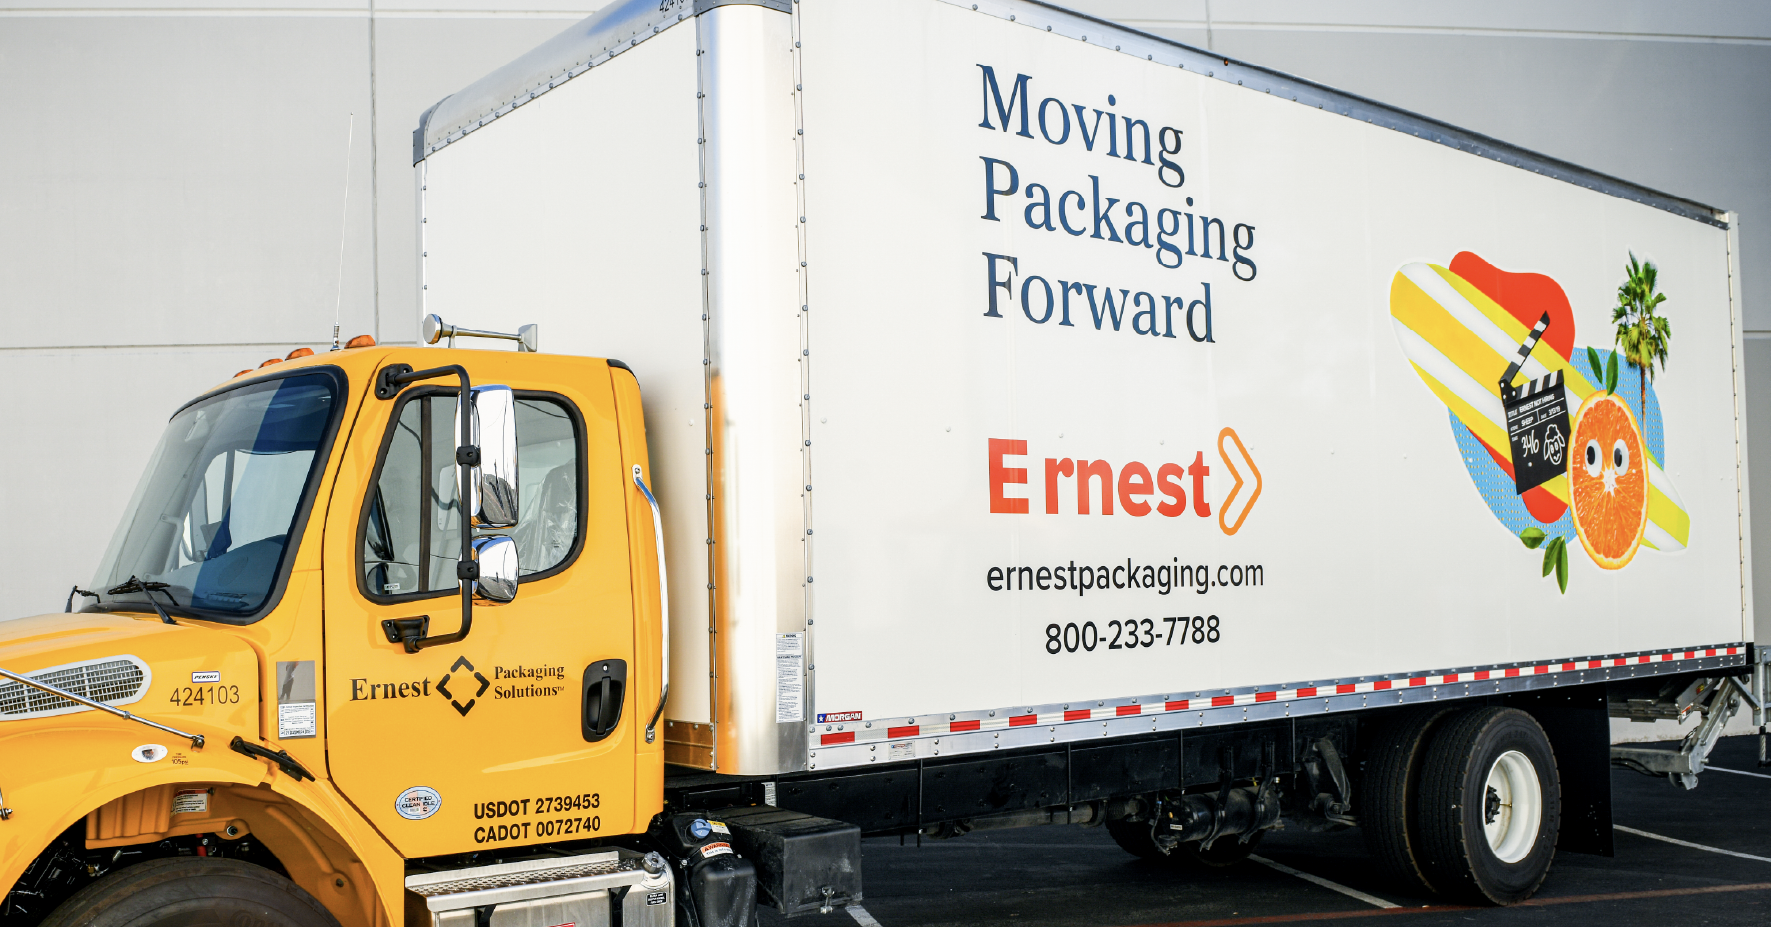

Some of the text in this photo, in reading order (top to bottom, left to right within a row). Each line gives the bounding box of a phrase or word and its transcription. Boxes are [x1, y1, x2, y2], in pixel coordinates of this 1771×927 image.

[976, 63, 1185, 188] Moving
[979, 155, 1257, 282] Packaging
[981, 251, 1216, 344] Forward
[1521, 416, 1534, 427] SHEEP
[1521, 429, 1540, 458] 346
[988, 437, 1212, 518] Ernest
[987, 556, 1264, 597] ernestpackaging.com
[1045, 614, 1221, 655] 800-233-7788
[494, 664, 565, 681] Packaging
[170, 685, 240, 707] 424103
[349, 677, 432, 702] Ernest
[825, 712, 862, 722] MORGAN
[474, 793, 600, 820] USDOT 2739453
[474, 815, 601, 844] CADOT 0072740
